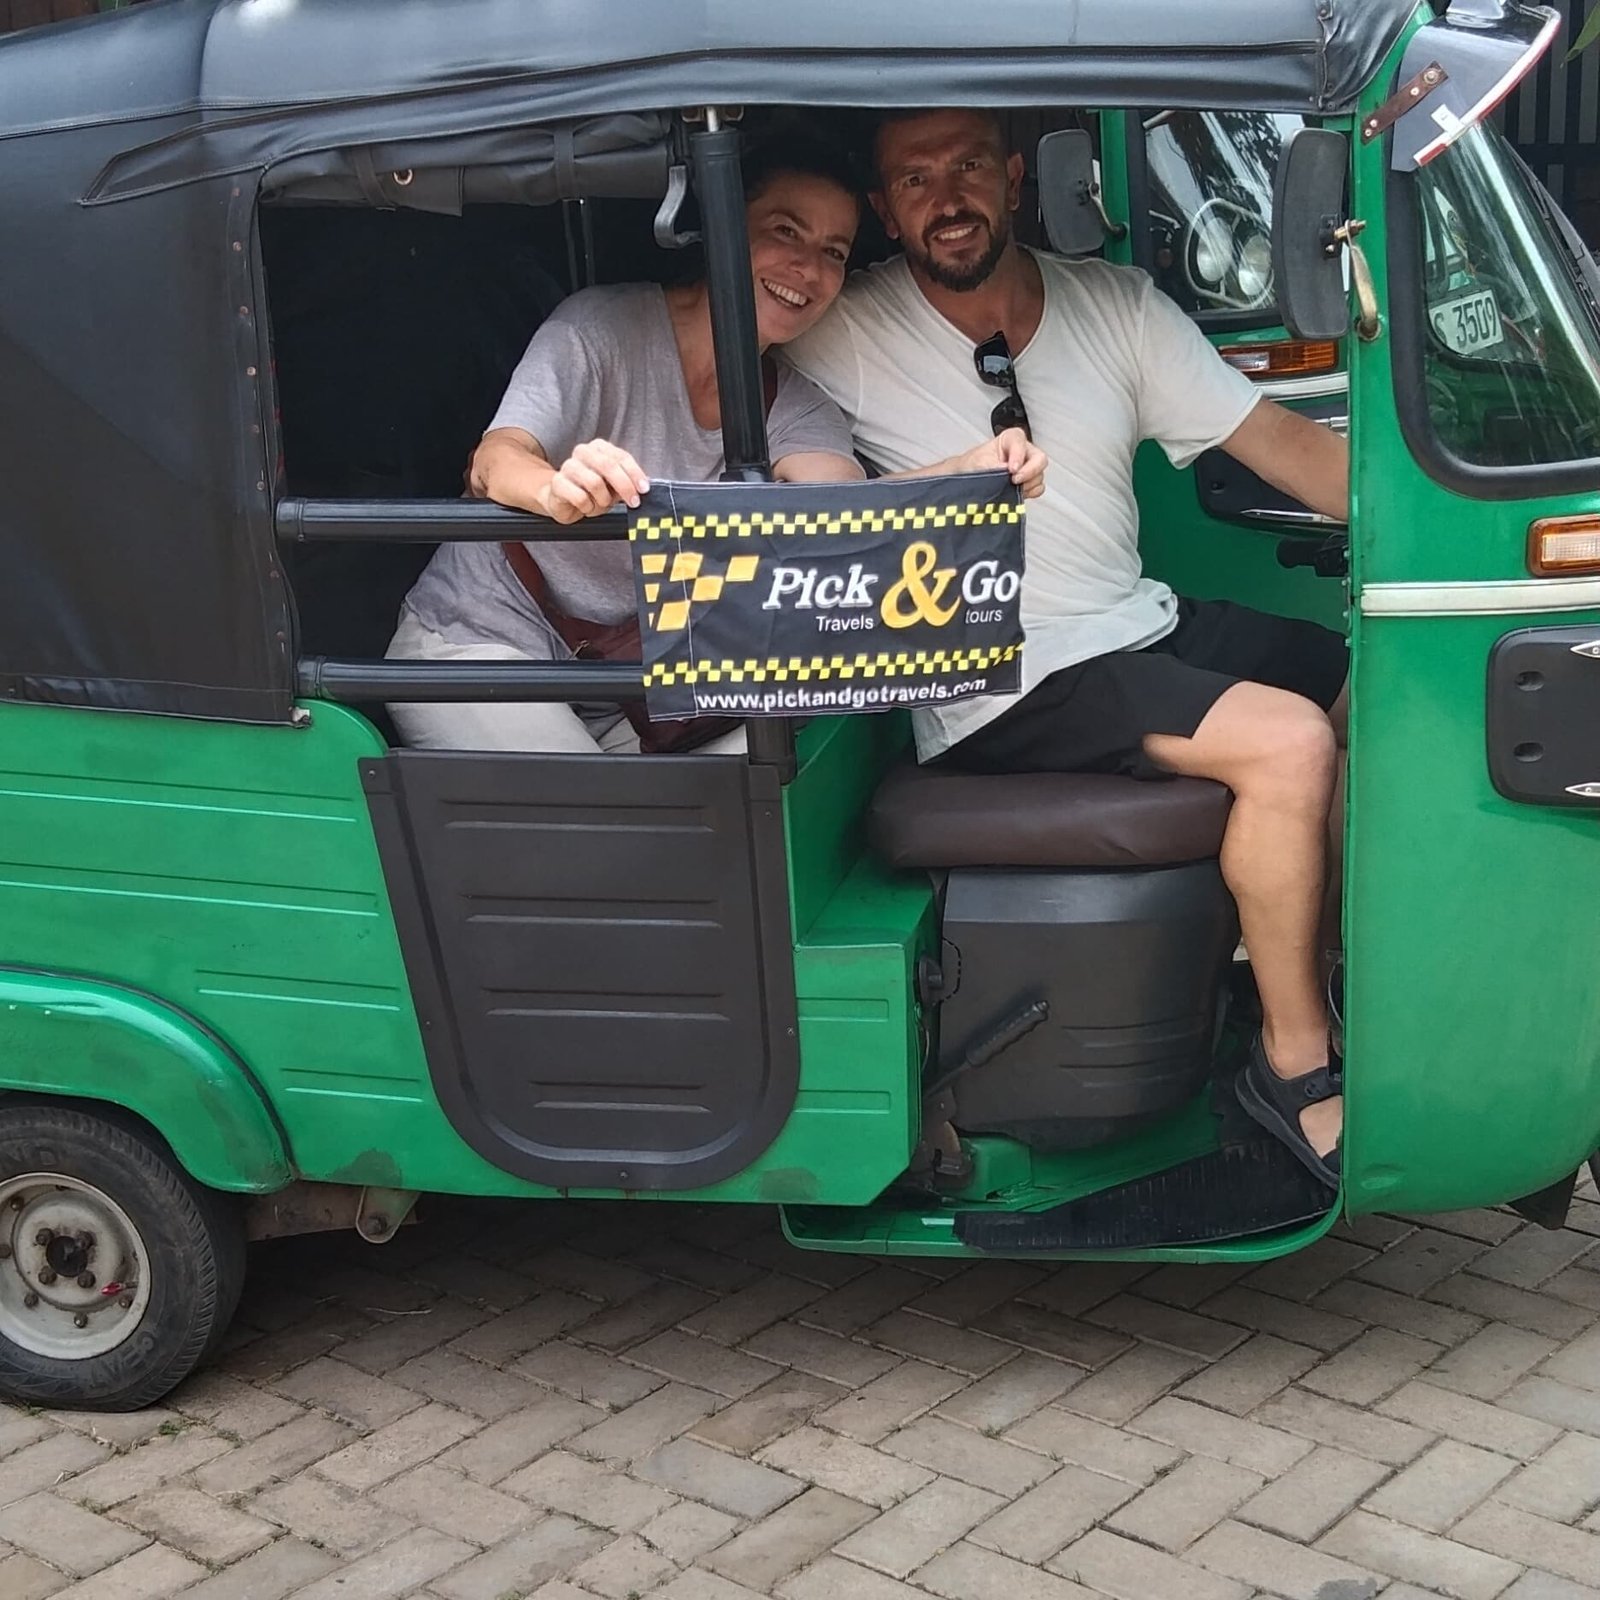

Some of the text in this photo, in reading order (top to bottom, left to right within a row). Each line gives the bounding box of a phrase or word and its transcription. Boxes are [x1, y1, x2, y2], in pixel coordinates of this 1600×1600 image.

[1452, 297, 1497, 349] 3509
[762, 541, 1020, 629] Pick & Go
[815, 607, 1003, 633] Travels tours
[697, 678, 986, 712] www.pickandgotravels.com
